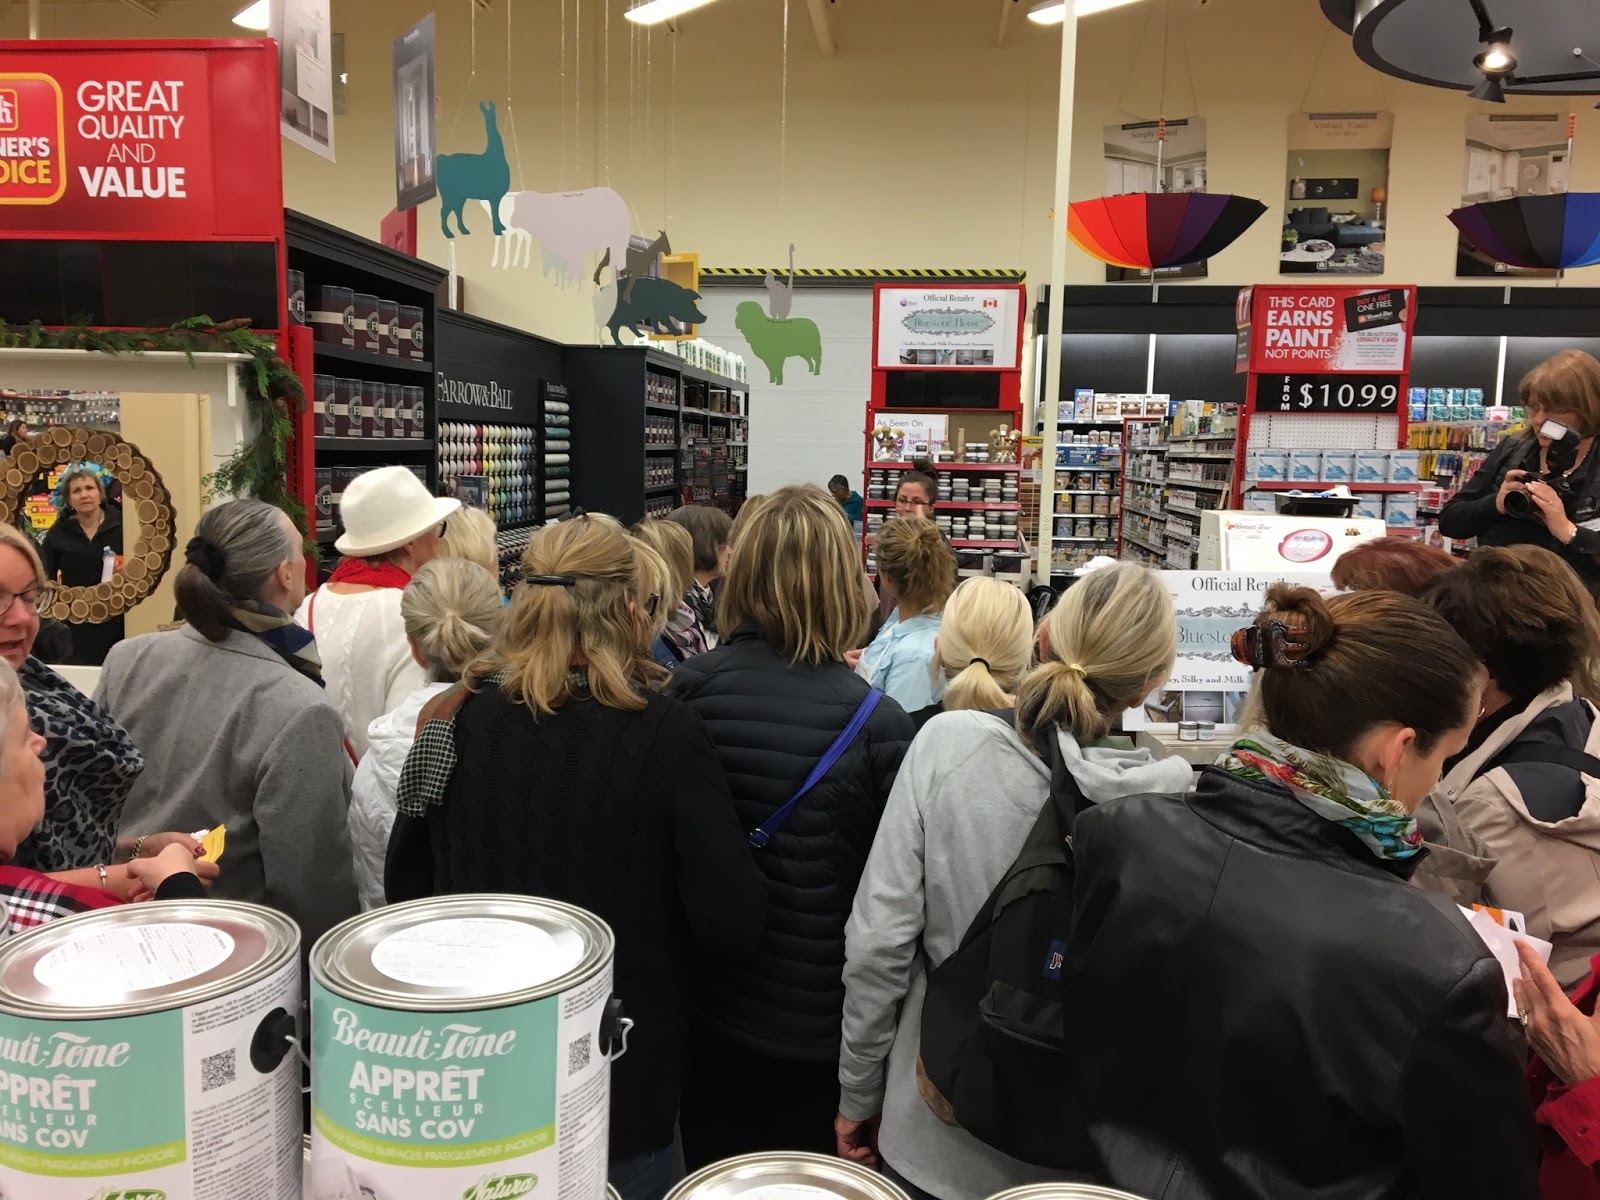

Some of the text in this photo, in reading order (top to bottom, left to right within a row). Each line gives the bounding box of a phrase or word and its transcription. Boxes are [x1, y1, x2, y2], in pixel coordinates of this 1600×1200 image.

[77, 80, 184, 112] GREAT
[77, 114, 185, 140] QUALITY
[106, 143, 156, 163] AND
[78, 166, 187, 198] VALUE
[923, 294, 975, 302] Official Retailer
[1269, 296, 1336, 308] THIS CARD
[1357, 299, 1392, 313] ONE FREE
[1267, 310, 1334, 326] EARNS
[1265, 328, 1333, 347] PAINT
[1264, 349, 1331, 359] NOT POINTS
[1280, 375, 1291, 411] FROM
[1299, 383, 1398, 409] $10.99
[876, 419, 923, 427] As Seen On
[691, 487, 710, 496] STAIN
[1191, 577, 1242, 592] Official
[1177, 626, 1233, 645] Bluesto
[1181, 674, 1204, 685] Silky
[1205, 675, 1221, 684] and
[1224, 675, 1244, 684] Milk
[349, 1060, 485, 1102] APPRÊT
[349, 1092, 484, 1117] SCELLEUR
[355, 1109, 412, 1138] SANS
[420, 1118, 476, 1139] COV
[35, 1127, 89, 1148] COV
[424, 1145, 501, 1161] PRATIQUEMENT
[468, 1173, 536, 1200] Natura
